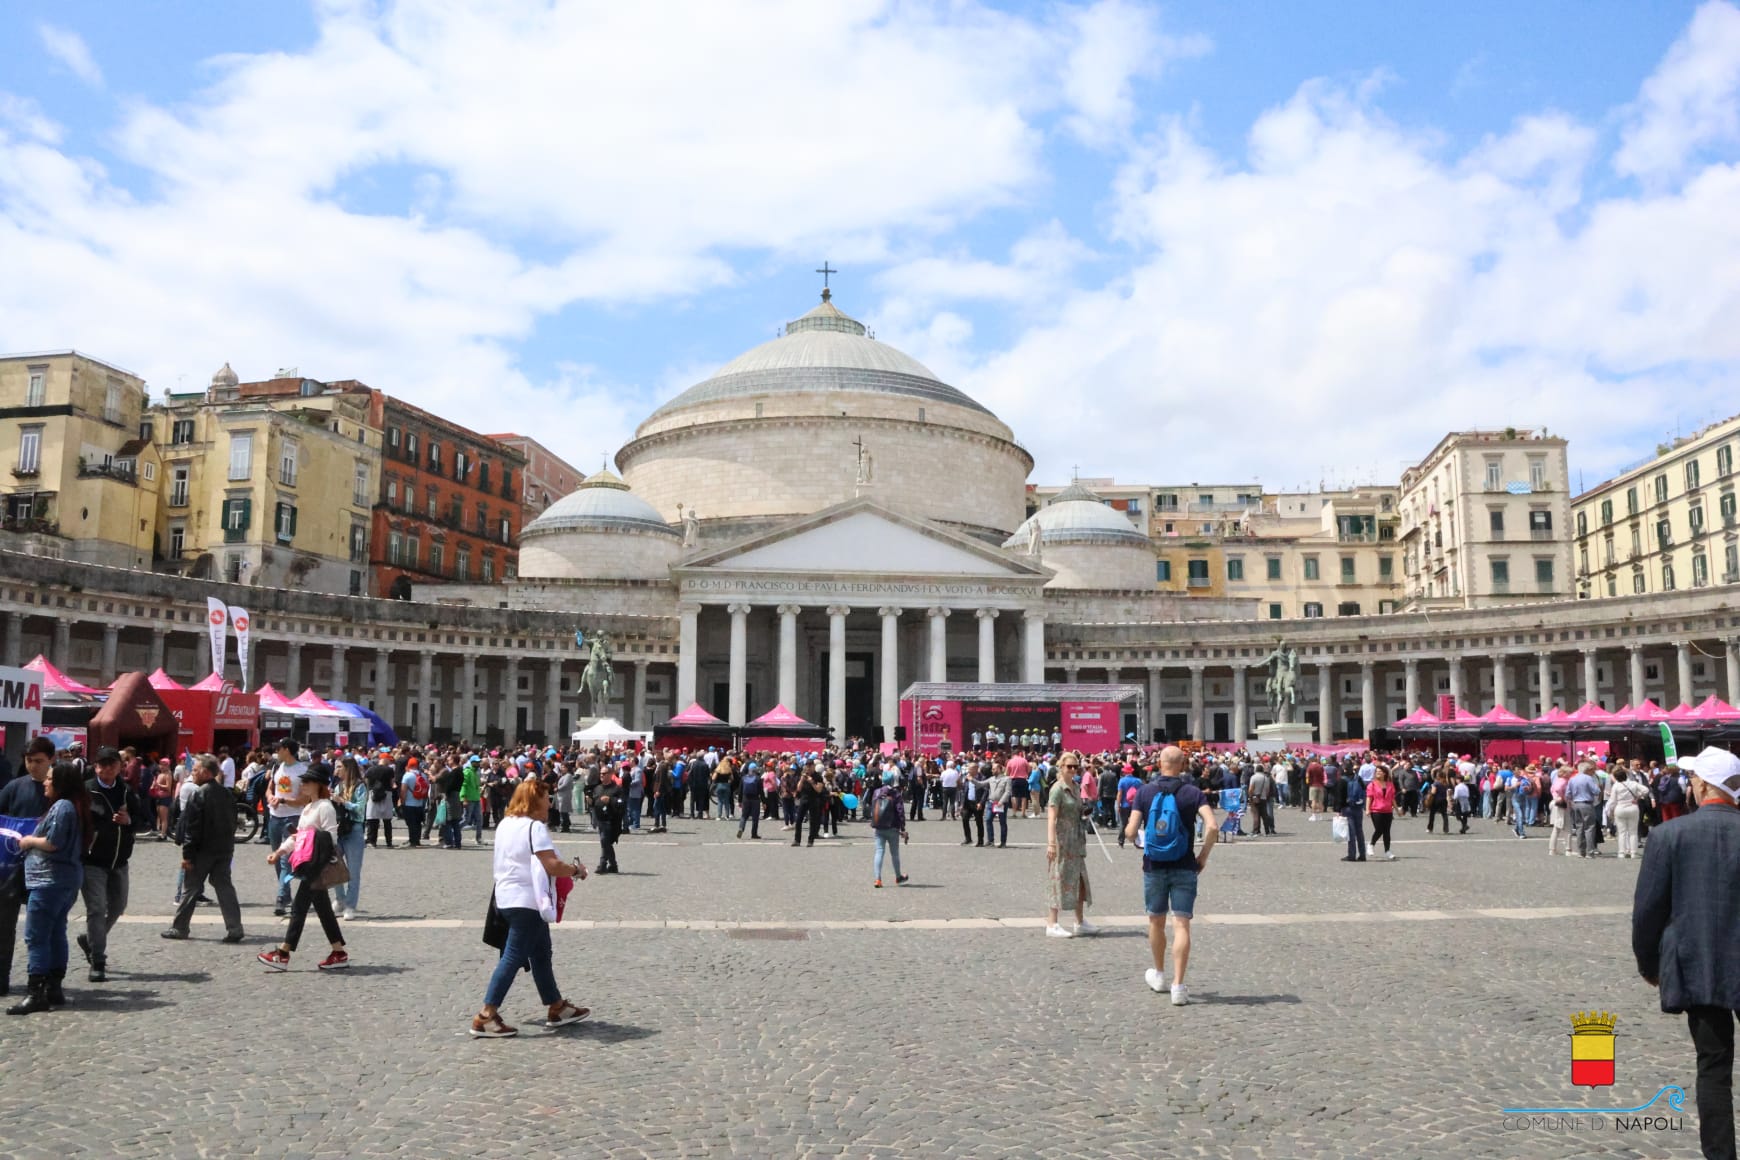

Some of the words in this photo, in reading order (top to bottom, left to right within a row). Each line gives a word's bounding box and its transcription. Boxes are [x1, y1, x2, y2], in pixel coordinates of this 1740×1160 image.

[724, 580, 731, 589] D
[735, 580, 794, 590] FRANCISCO
[798, 581, 811, 591] DE
[851, 582, 920, 593] FERDINANDVS
[944, 584, 973, 594] VOTO
[0, 678, 41, 711] MA
